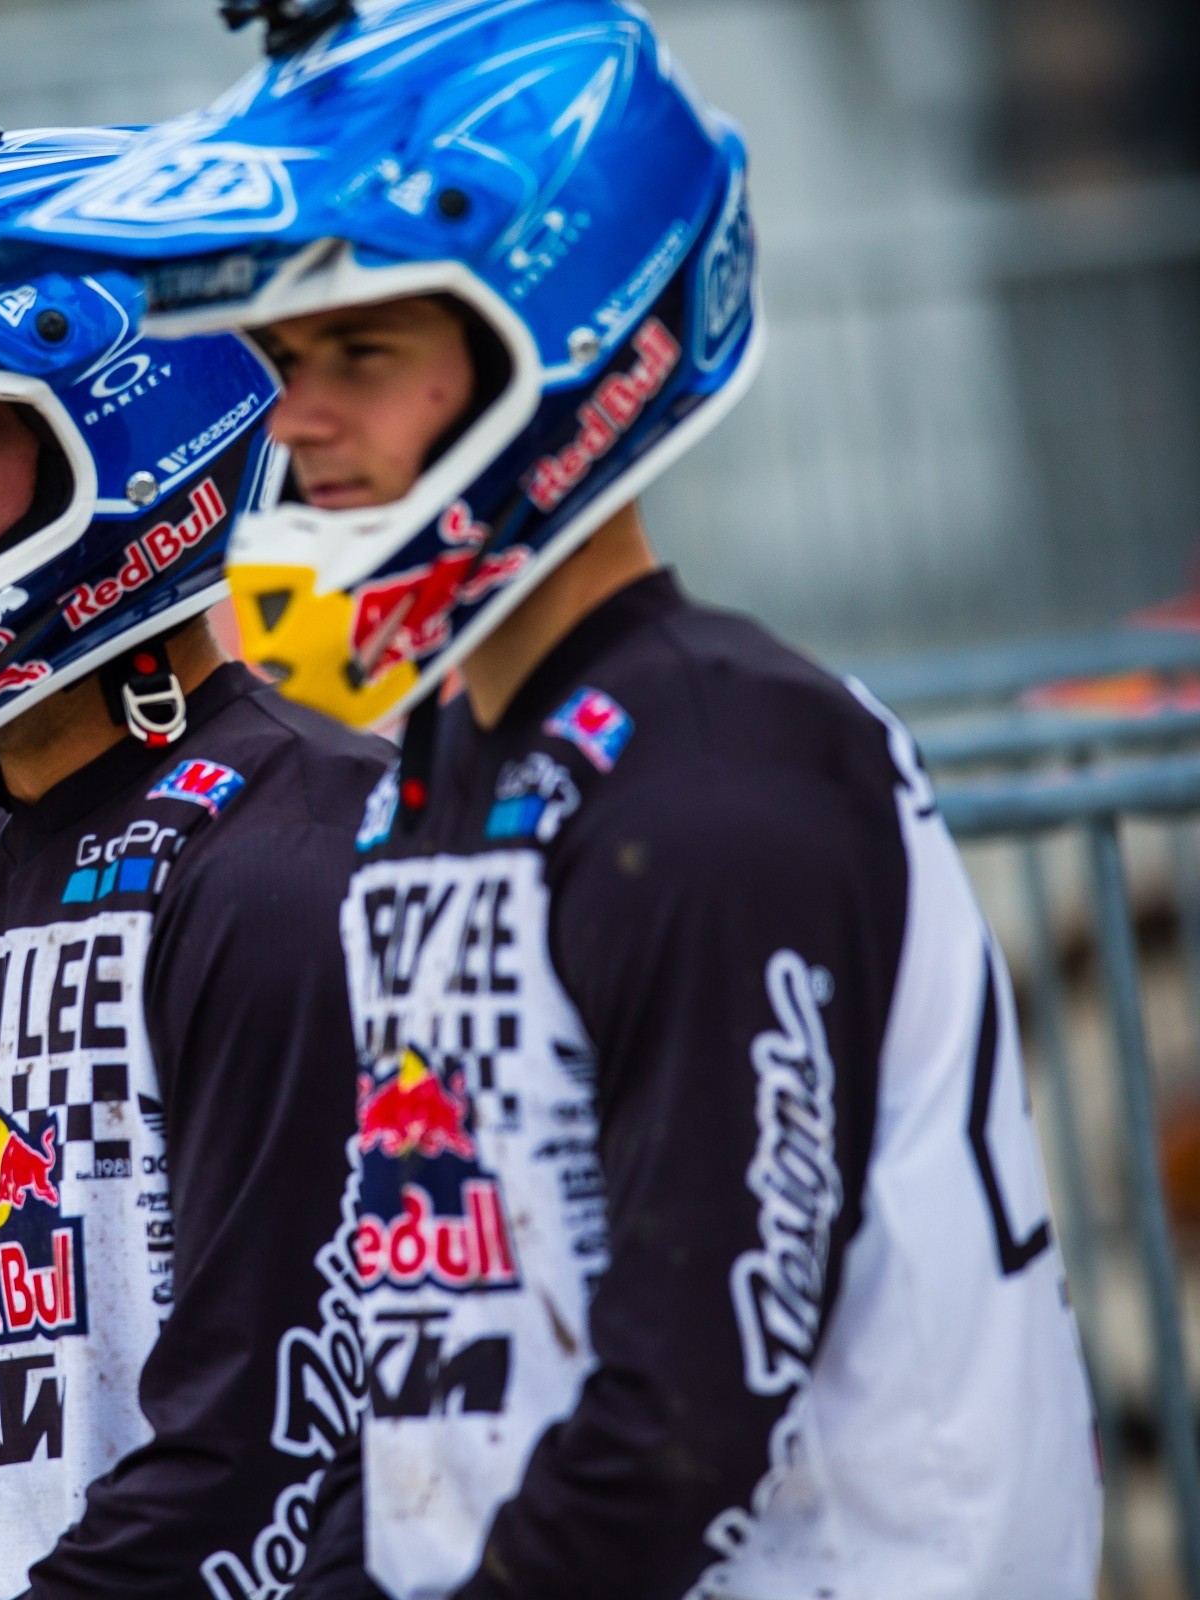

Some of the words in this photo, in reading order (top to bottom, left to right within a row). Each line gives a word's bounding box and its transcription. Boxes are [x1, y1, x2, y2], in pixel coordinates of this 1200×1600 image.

[83, 362, 172, 426] OAKLEY
[188, 392, 259, 456] seaspan
[58, 540, 154, 632] Red
[140, 476, 227, 573] Bull
[16, 934, 127, 1060] LEE
[97, 1156, 132, 1178] 1981
